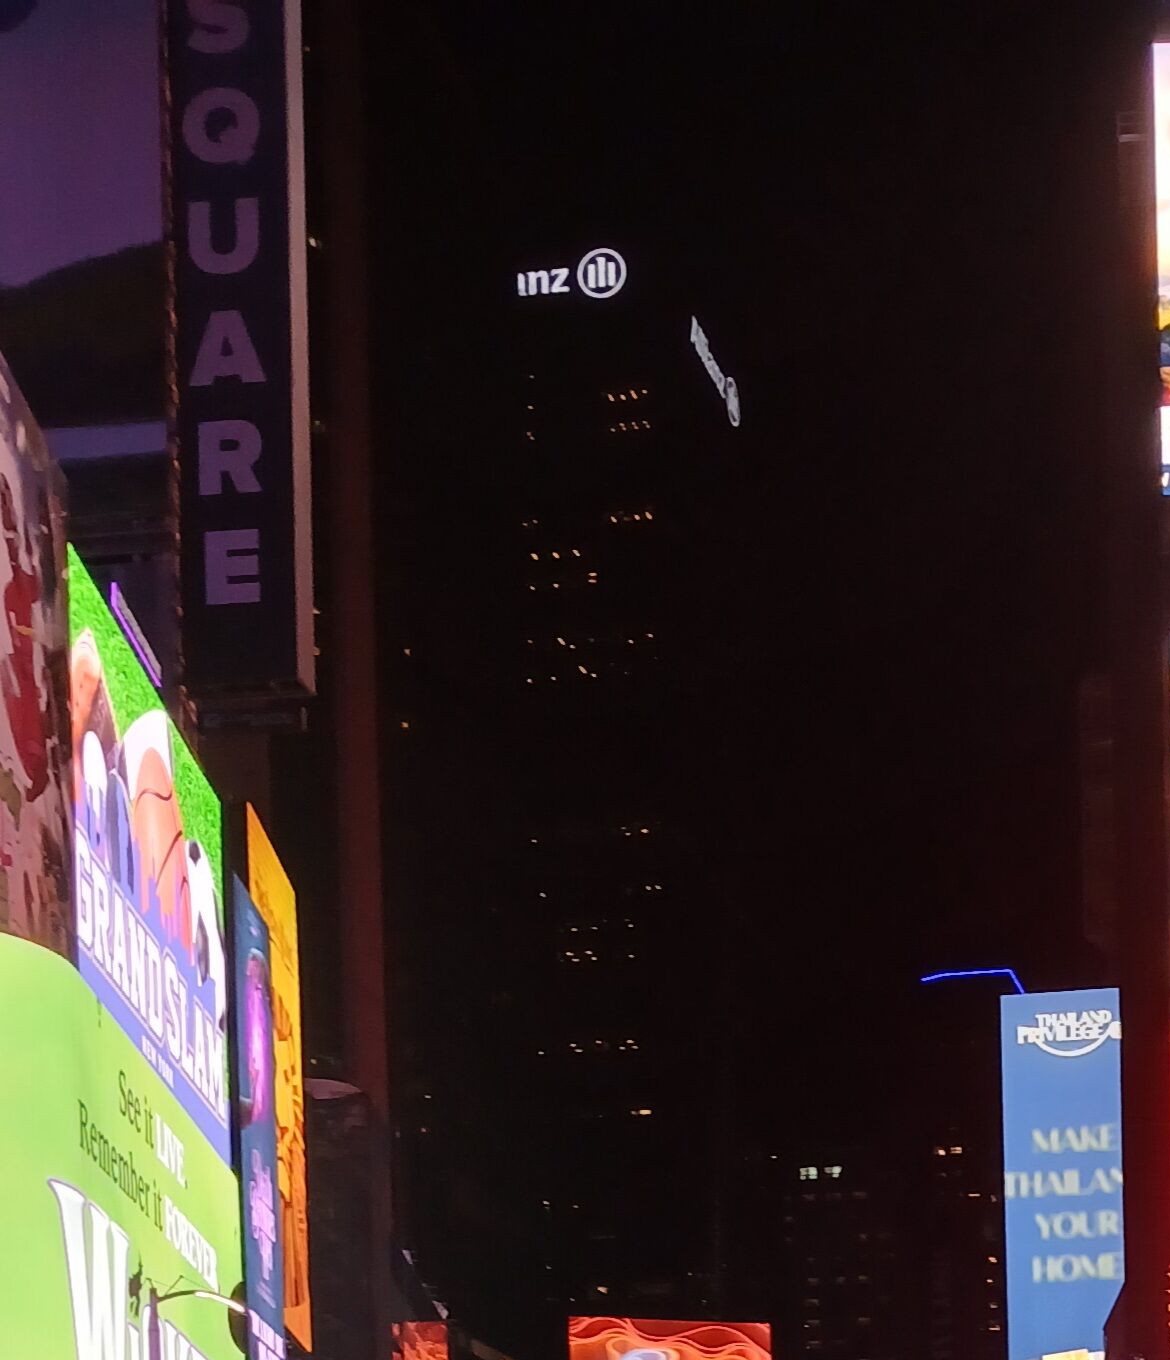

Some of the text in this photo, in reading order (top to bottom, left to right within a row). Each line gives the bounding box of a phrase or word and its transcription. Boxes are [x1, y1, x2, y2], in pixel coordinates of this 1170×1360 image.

[182, 0, 267, 605] SQUARE
[76, 828, 227, 1122] GRAND SLAM
[1035, 1009, 1113, 1028] THAILAND
[118, 1070, 141, 1133] See
[144, 1096, 154, 1150] it
[77, 1098, 151, 1218] Remember
[153, 1180, 163, 1232] it
[1032, 1123, 1117, 1154] MAKE
[1035, 1208, 1119, 1240] YOUR
[1031, 1251, 1121, 1283] HOME
